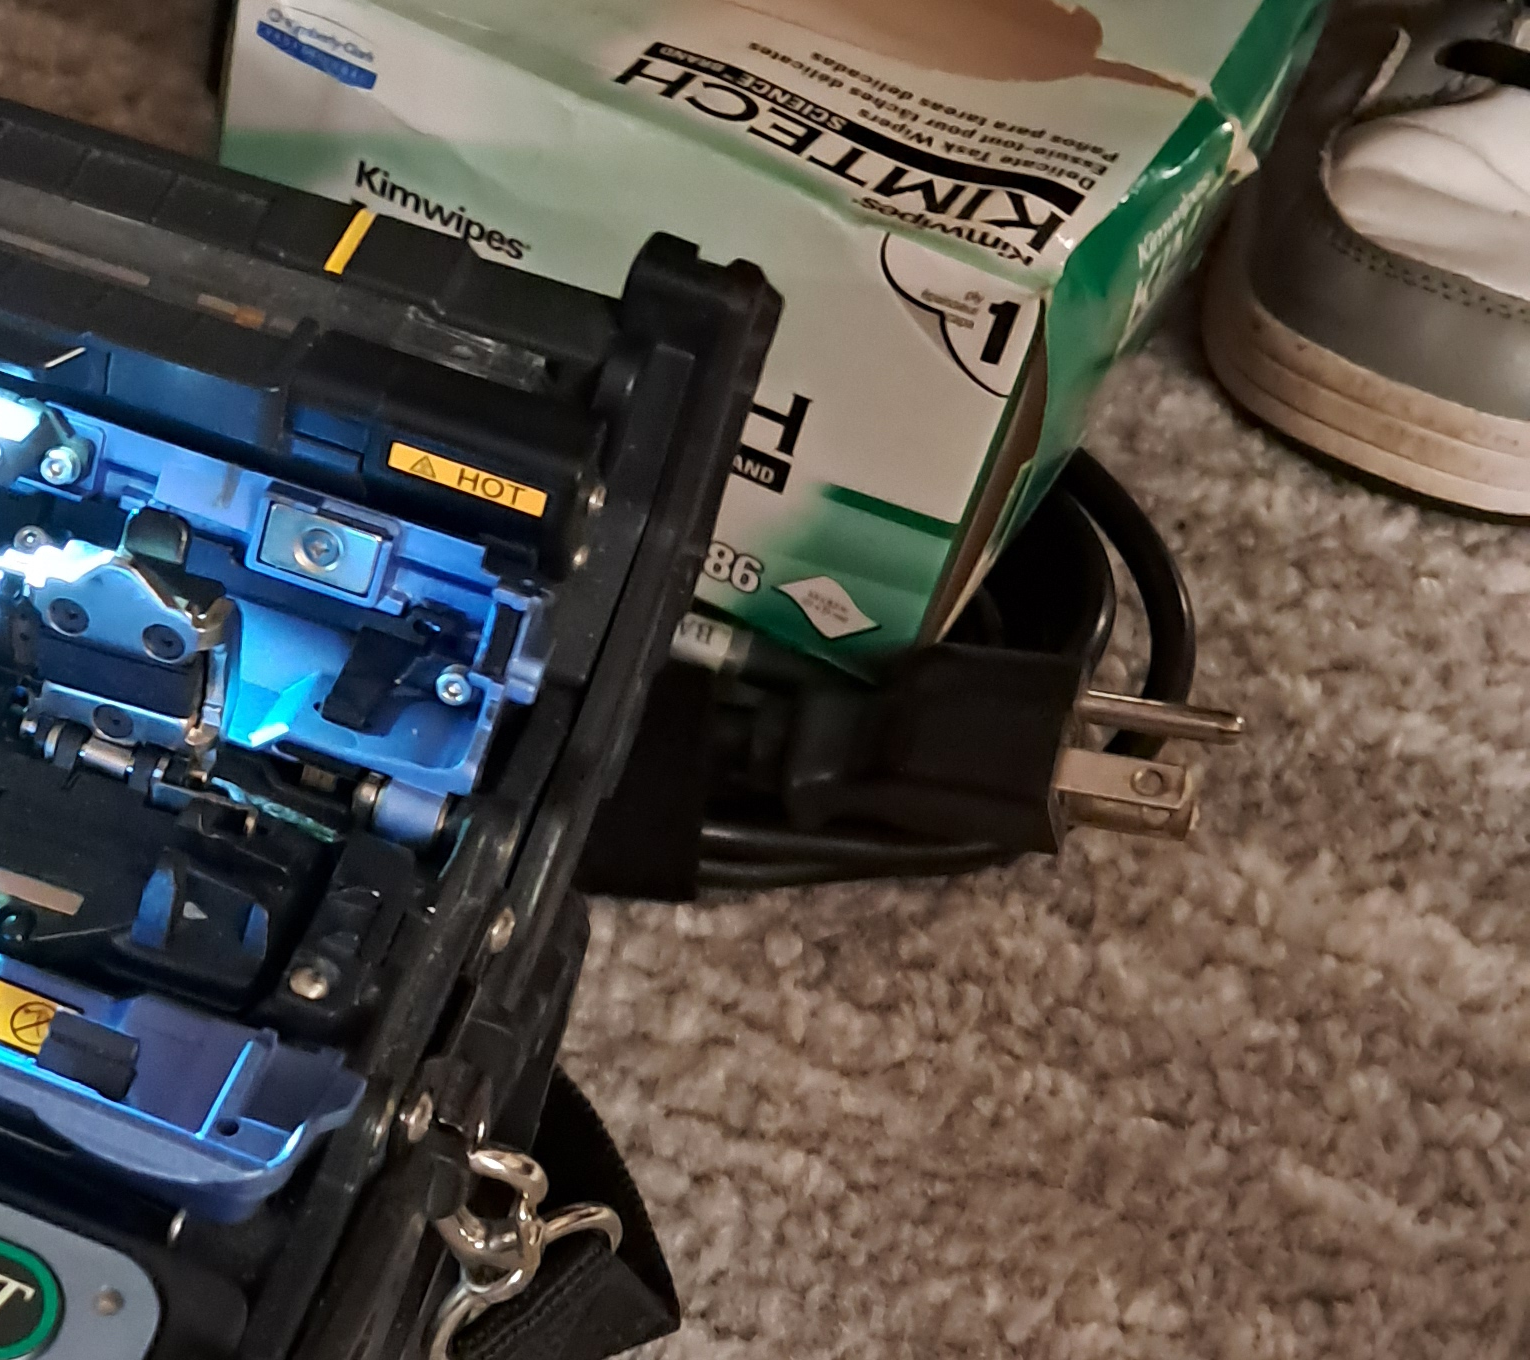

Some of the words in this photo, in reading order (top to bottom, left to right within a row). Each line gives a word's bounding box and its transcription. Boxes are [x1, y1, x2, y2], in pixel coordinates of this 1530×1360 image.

[659, 44, 732, 76] BRAND
[811, 51, 916, 97] delicadas
[857, 106, 934, 148] Wipers
[919, 95, 986, 129] tareas
[932, 113, 979, 143] pour
[991, 117, 1048, 138] para
[612, 56, 1067, 255] KIMTECH
[945, 138, 995, 165] Task
[998, 153, 1096, 192] Delicate
[355, 159, 531, 262] Kimwipes
[856, 194, 1034, 268] Kimwipes
[979, 299, 1021, 366] 1
[456, 467, 526, 506] HOT
[732, 453, 775, 485] AND
[703, 541, 765, 593] 86
